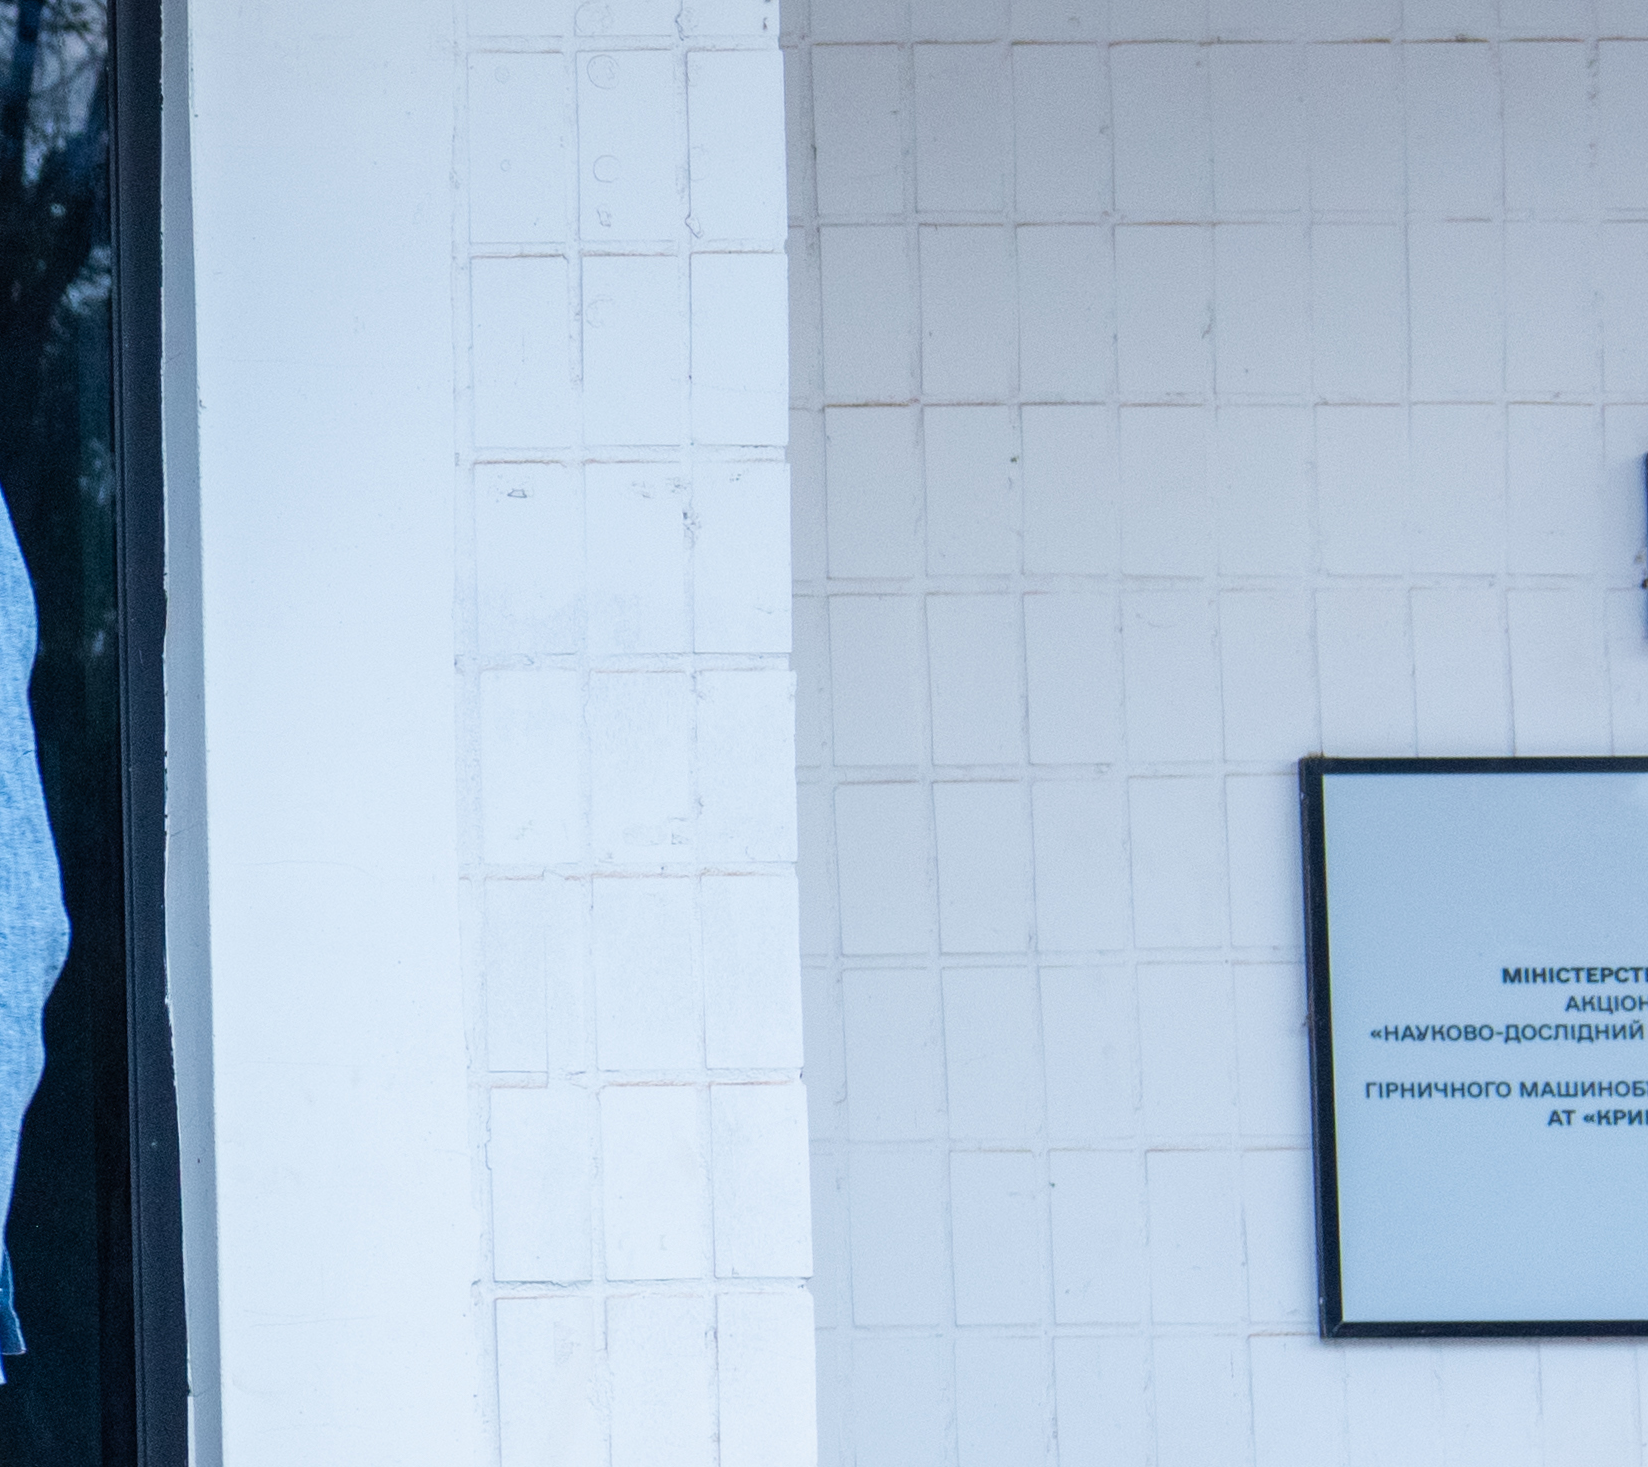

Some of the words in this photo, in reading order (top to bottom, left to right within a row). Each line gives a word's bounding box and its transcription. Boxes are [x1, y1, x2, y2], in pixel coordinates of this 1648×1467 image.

[1369, 1020, 1645, 1045] «НАУКОВО-ДОСЛІДНИЙ
[1364, 1080, 1513, 1100] ГІРНИЧНОГО
[1518, 1080, 1648, 1099] МАШИНОБ
[1546, 1109, 1578, 1127] АТ
[1583, 1108, 1648, 1127] «КРИ
